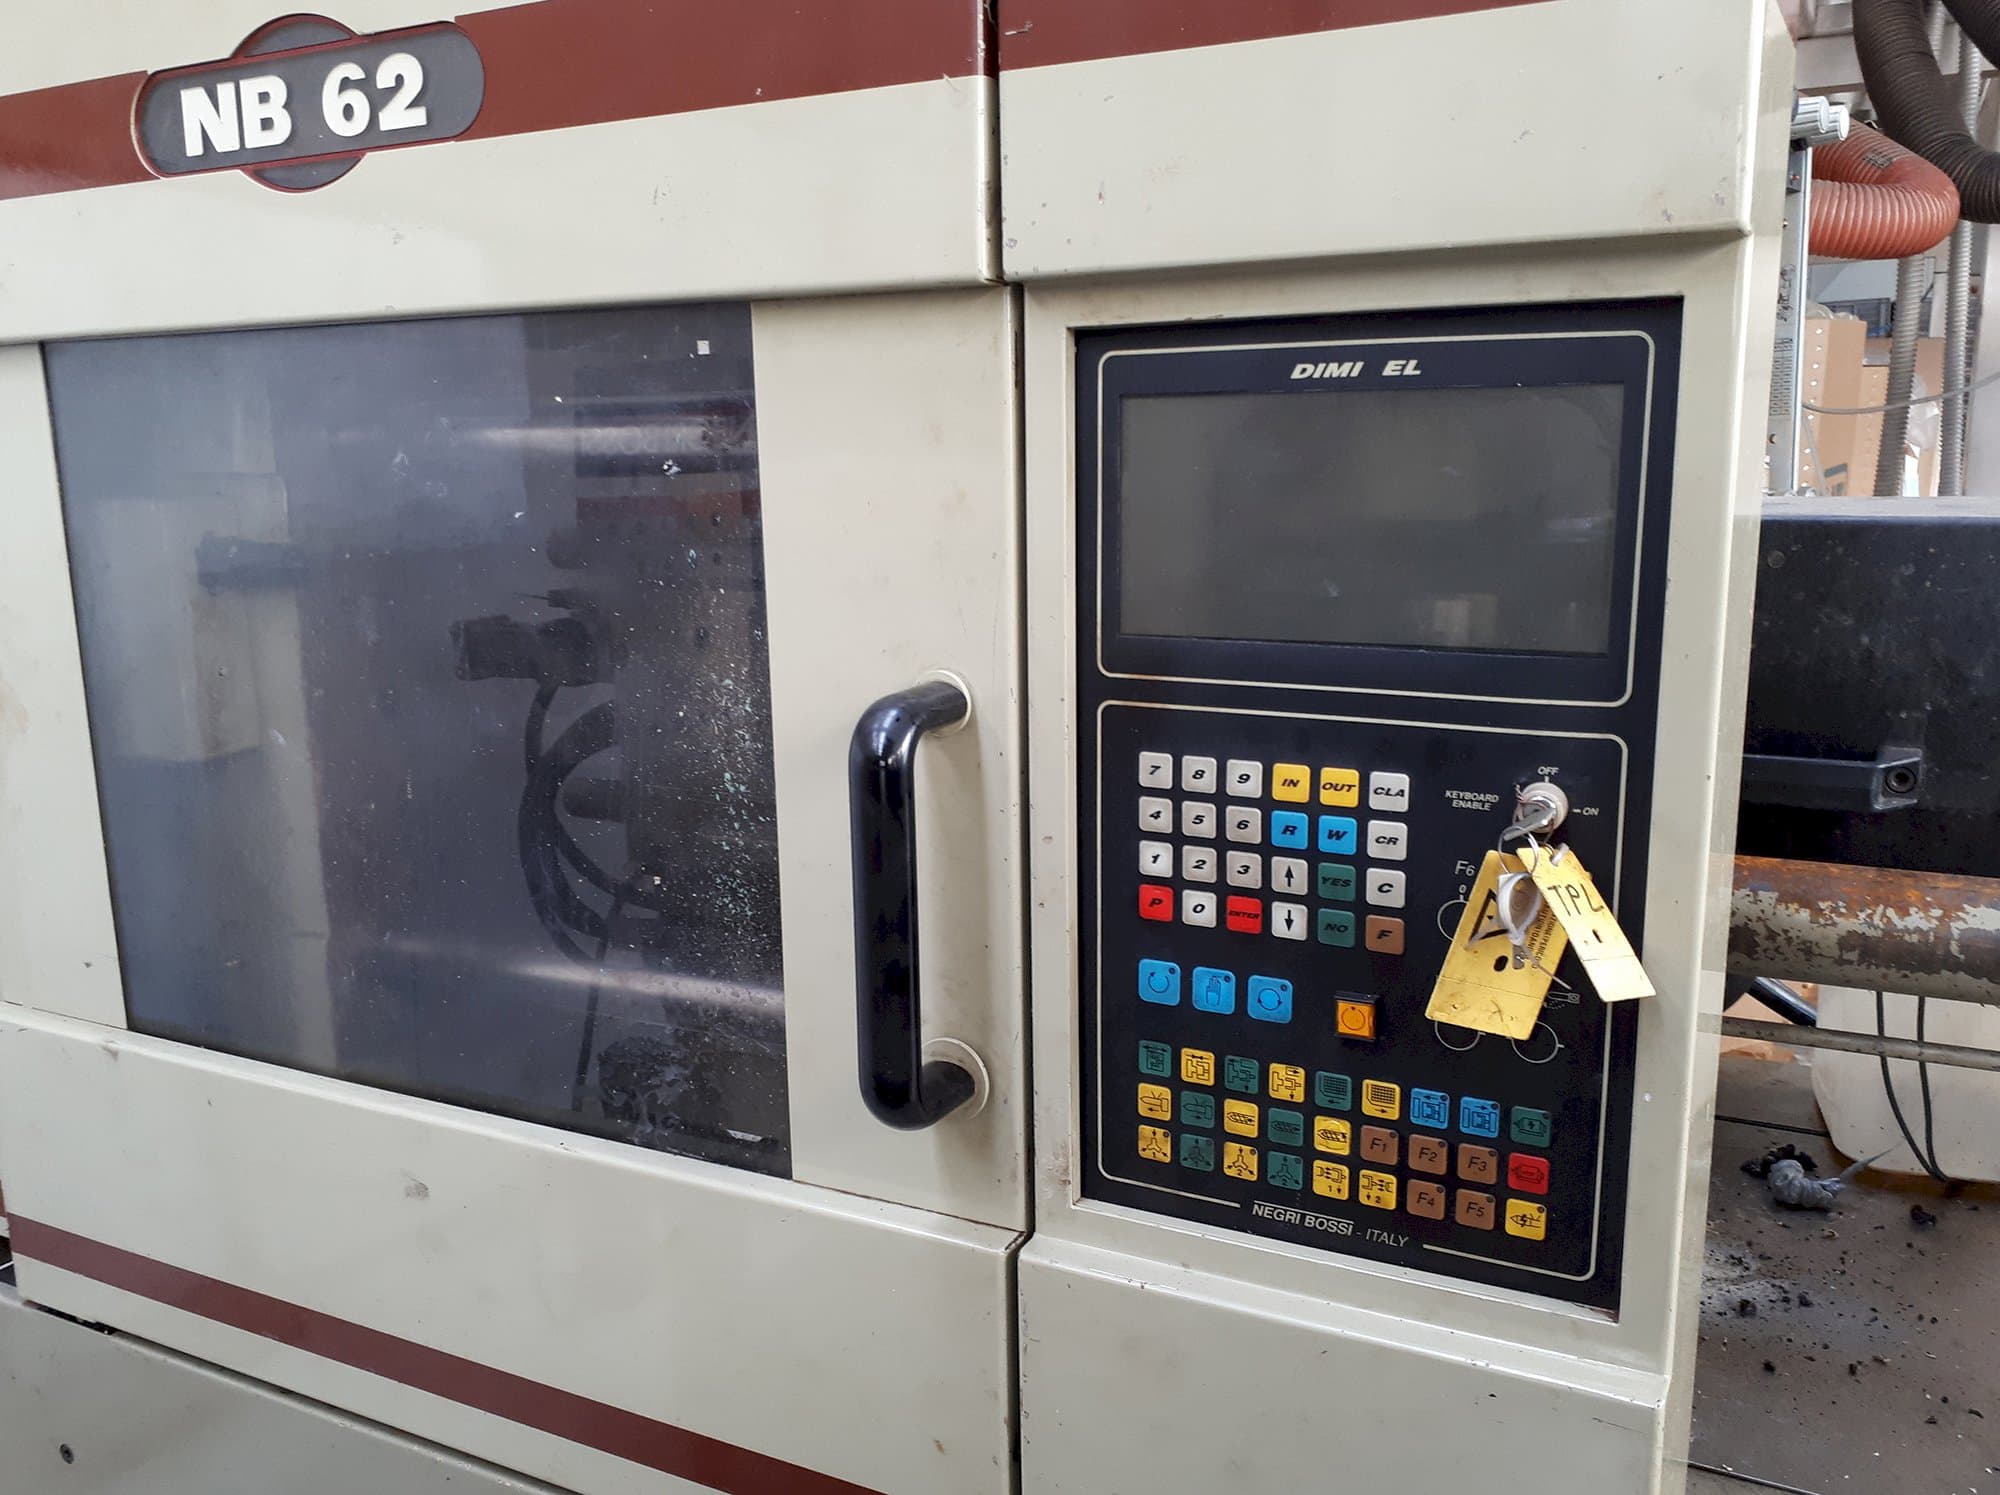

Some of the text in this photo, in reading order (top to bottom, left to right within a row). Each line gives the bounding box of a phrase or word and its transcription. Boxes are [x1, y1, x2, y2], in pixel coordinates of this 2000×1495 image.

[179, 52, 428, 158] NB 62
[1290, 359, 1422, 380] DIMI EL
[1149, 765, 1162, 776] 7
[1191, 769, 1206, 780] 8
[1537, 766, 1559, 776] OFF
[1236, 773, 1251, 784] 9
[1281, 778, 1300, 788] IN
[1321, 782, 1356, 793] OUT
[1373, 786, 1406, 798] CLA
[1445, 790, 1499, 803] KEYBOARD
[1452, 800, 1492, 812] ENABLE
[1149, 810, 1162, 820] 4
[1582, 807, 1600, 817] ON
[1191, 815, 1206, 825] 5
[1236, 820, 1251, 830] 6
[1281, 825, 1298, 836] R
[1327, 829, 1348, 841] W
[1375, 835, 1400, 846] CR
[1151, 853, 1161, 864] 1
[1192, 859, 1207, 870] 2
[1236, 865, 1251, 875] 3
[1455, 860, 1476, 877] F6
[1321, 876, 1352, 888] YES
[1377, 883, 1394, 894] C
[1149, 898, 1163, 908] P
[1547, 883, 1604, 917] TPL
[1192, 903, 1206, 914] 0
[1228, 909, 1261, 920] ENTER
[1324, 923, 1349, 934] NO
[1377, 929, 1393, 940] F
[1370, 1138, 1387, 1154] F1
[1418, 1147, 1437, 1163] F2
[1467, 1156, 1488, 1172] F3
[1416, 1191, 1435, 1208] F4
[1465, 1201, 1486, 1218] F5
[1252, 1204, 1301, 1225] NEGRI
[1303, 1214, 1354, 1237] BOSSI
[1366, 1228, 1409, 1248] ITALY
